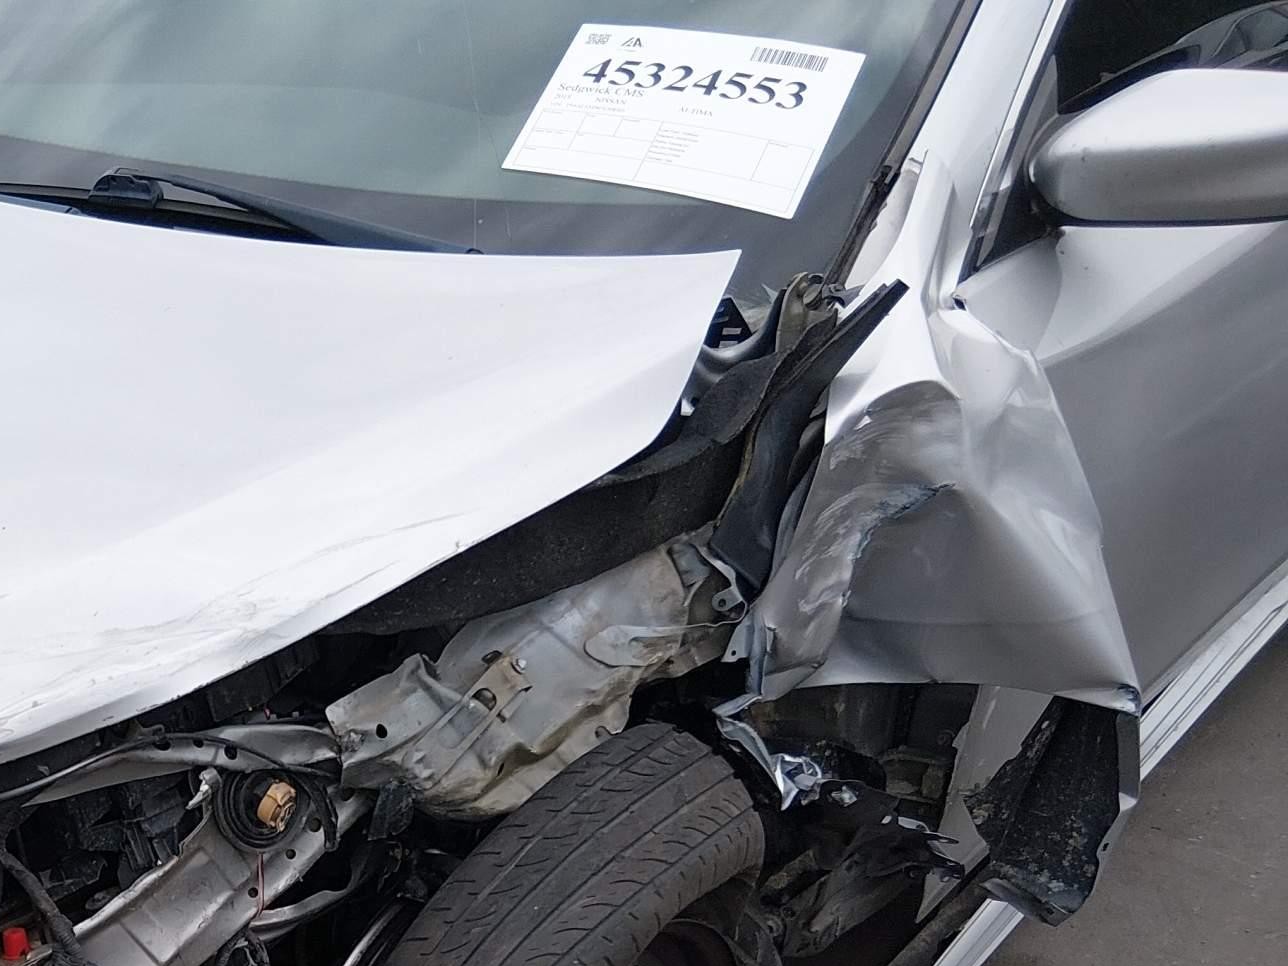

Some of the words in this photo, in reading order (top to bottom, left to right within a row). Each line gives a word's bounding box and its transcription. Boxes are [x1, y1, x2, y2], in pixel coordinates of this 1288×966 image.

[558, 83, 611, 96] Sedgwick
[614, 87, 646, 98] CMS
[583, 58, 808, 110] 45324553
